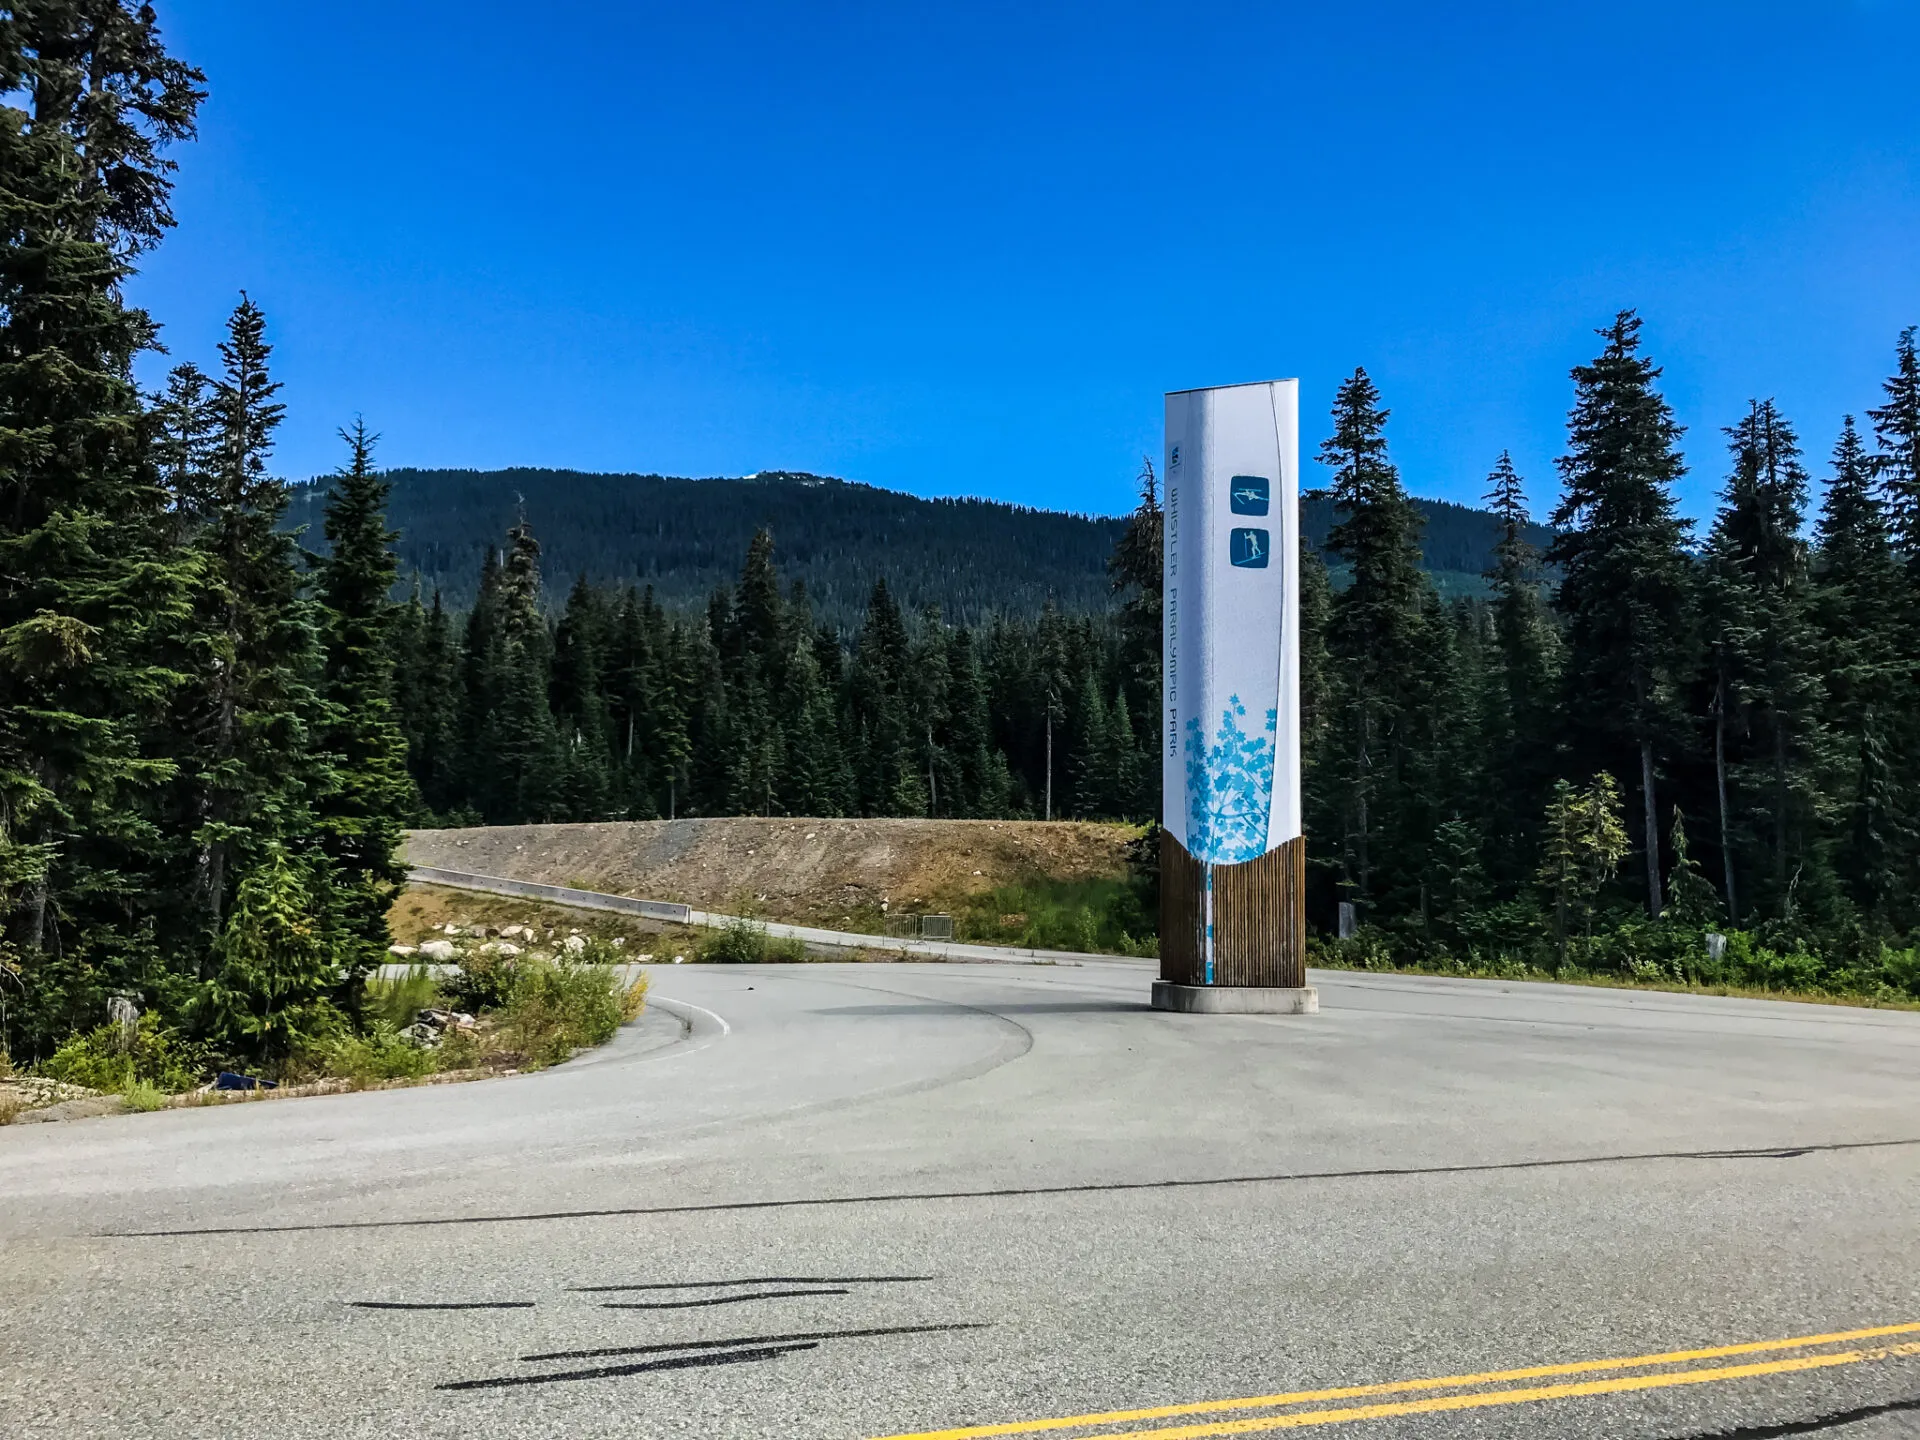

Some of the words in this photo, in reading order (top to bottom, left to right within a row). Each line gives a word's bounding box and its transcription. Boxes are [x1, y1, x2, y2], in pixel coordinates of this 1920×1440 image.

[1170, 487, 1178, 577] WHISTLER
[1169, 587, 1178, 702] PARALYMPIC
[1169, 708, 1177, 757] PARK
